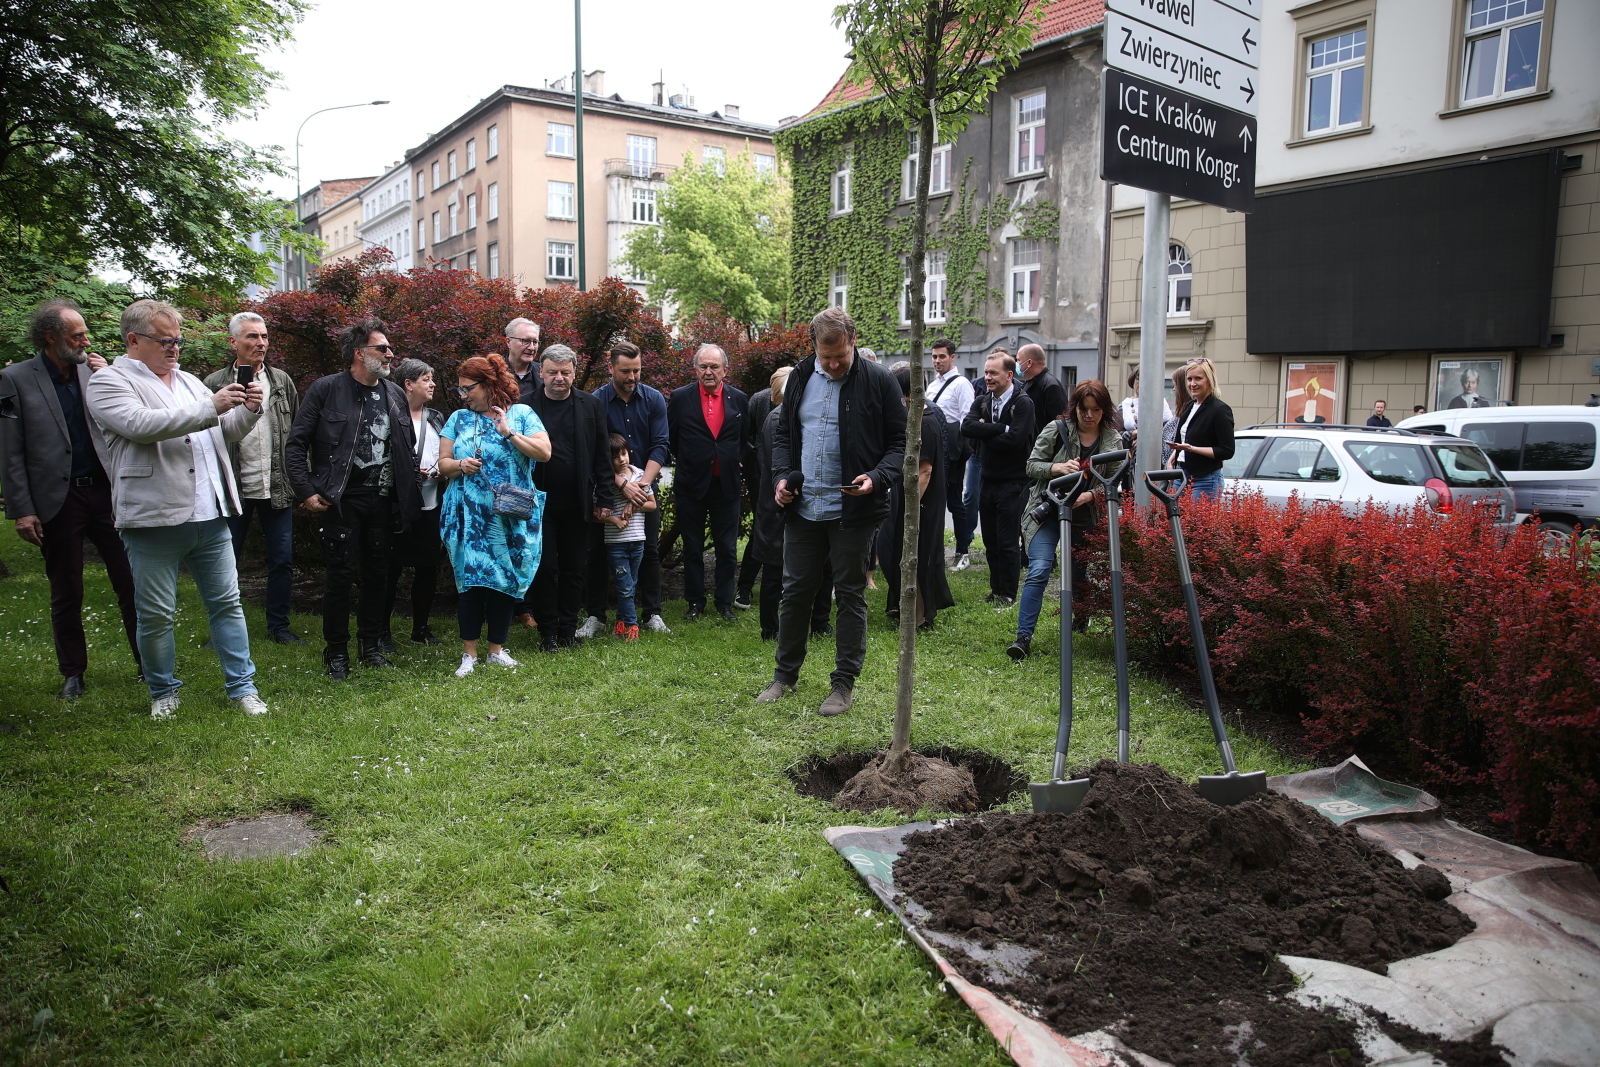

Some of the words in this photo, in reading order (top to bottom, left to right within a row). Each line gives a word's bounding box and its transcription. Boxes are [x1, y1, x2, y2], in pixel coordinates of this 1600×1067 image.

[1120, 26, 1222, 90] Zwierzyniec
[1118, 82, 1149, 118] ICE
[1155, 94, 1217, 138] Kraków
[1117, 124, 1190, 170] Centrum
[1196, 146, 1241, 188] Kongr.
